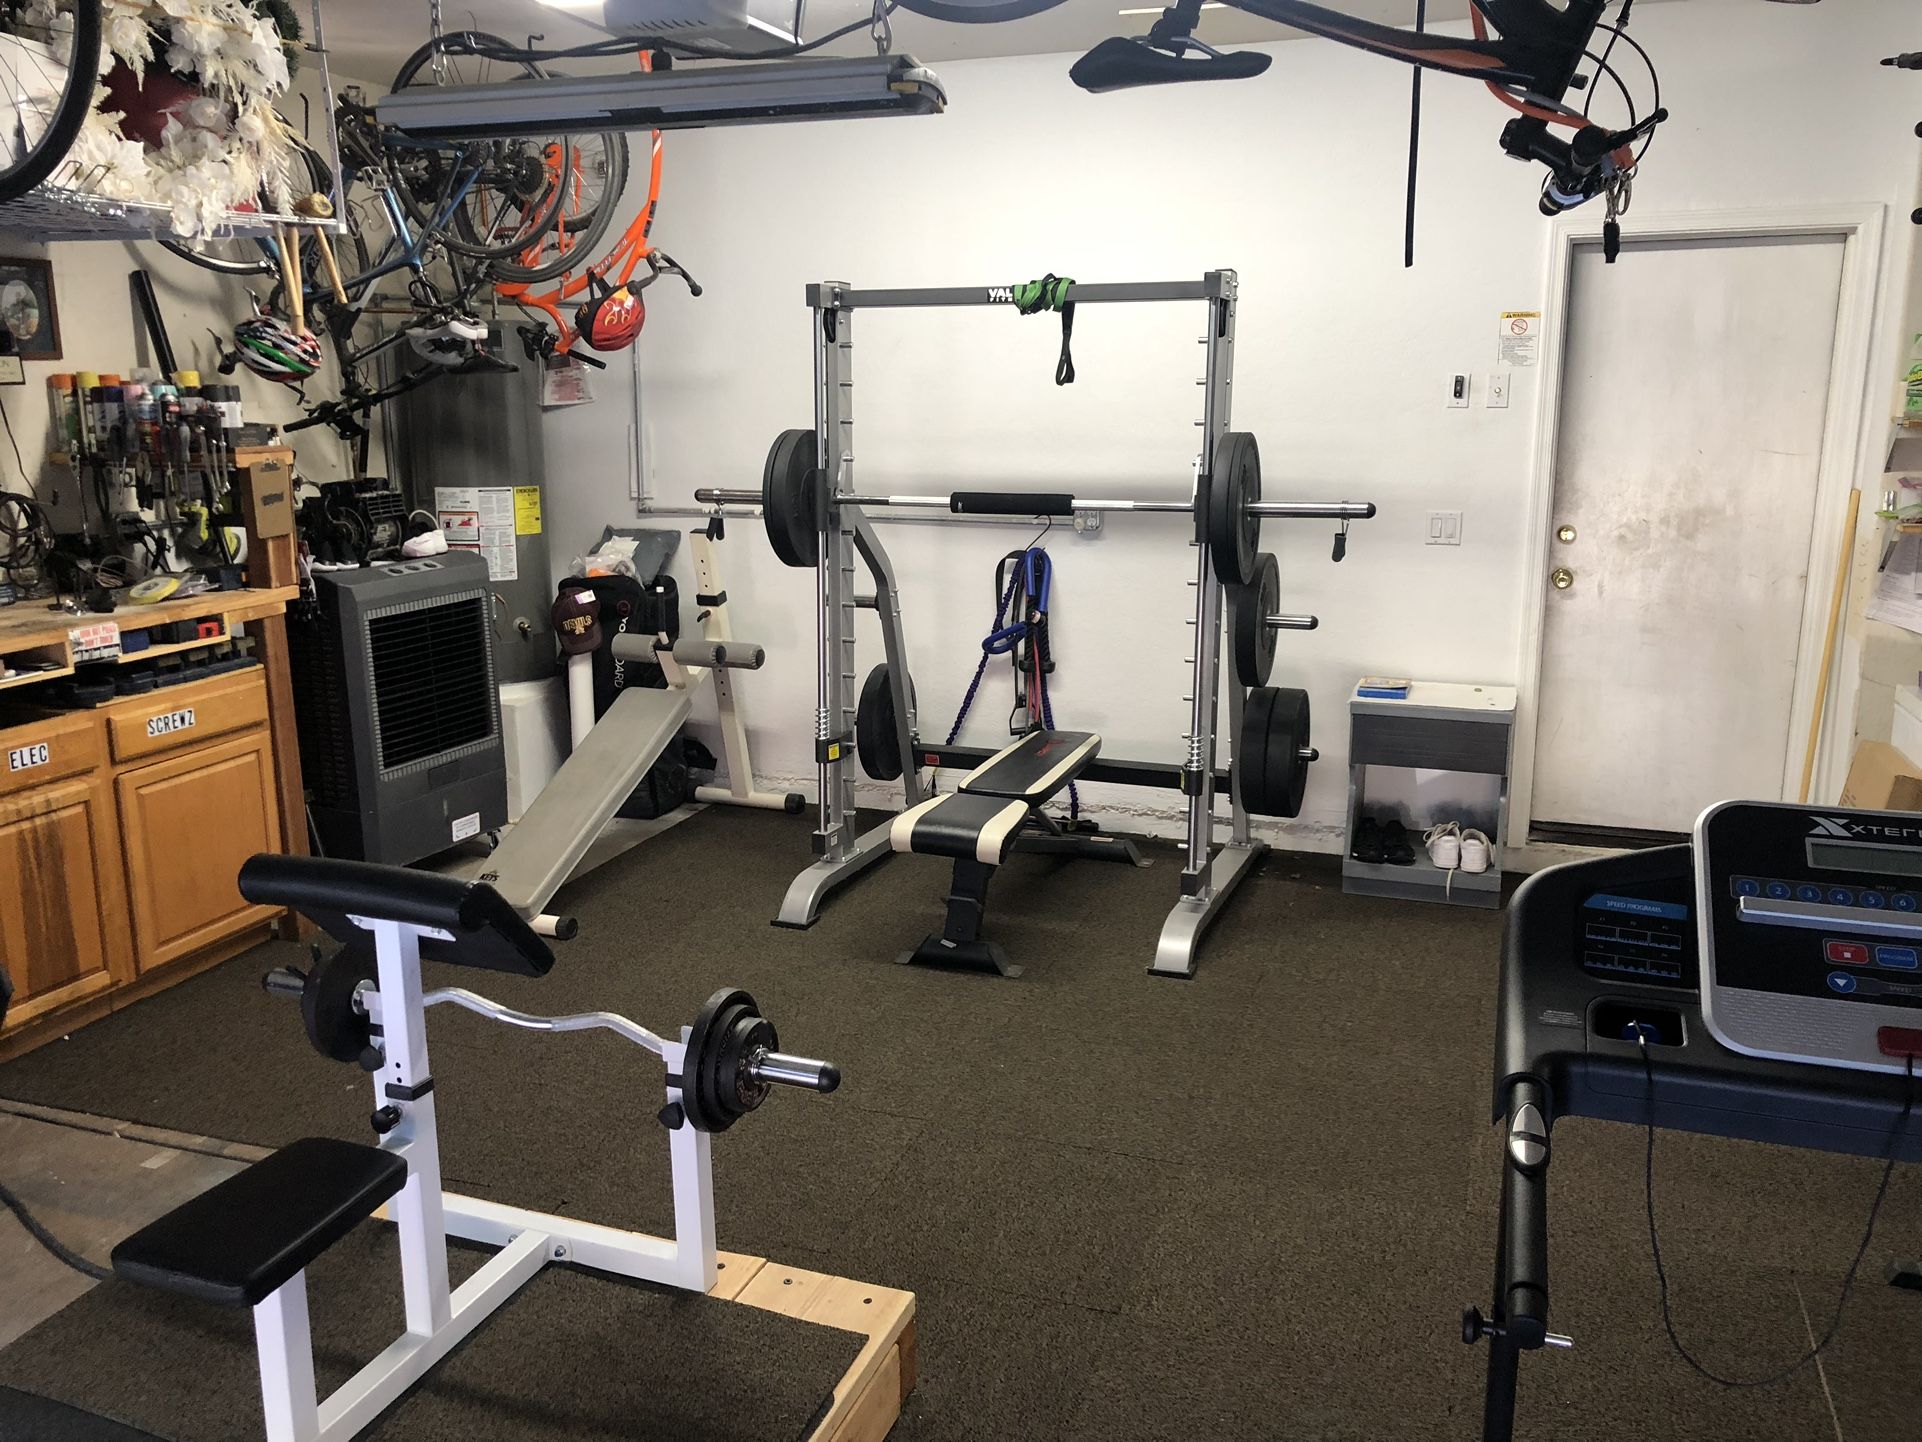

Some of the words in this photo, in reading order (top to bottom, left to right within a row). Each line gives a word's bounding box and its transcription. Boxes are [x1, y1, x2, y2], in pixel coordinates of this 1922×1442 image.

[148, 709, 194, 735] SCREWZ
[10, 745, 47, 770] ELEC
[1606, 899, 1626, 908] SPEED
